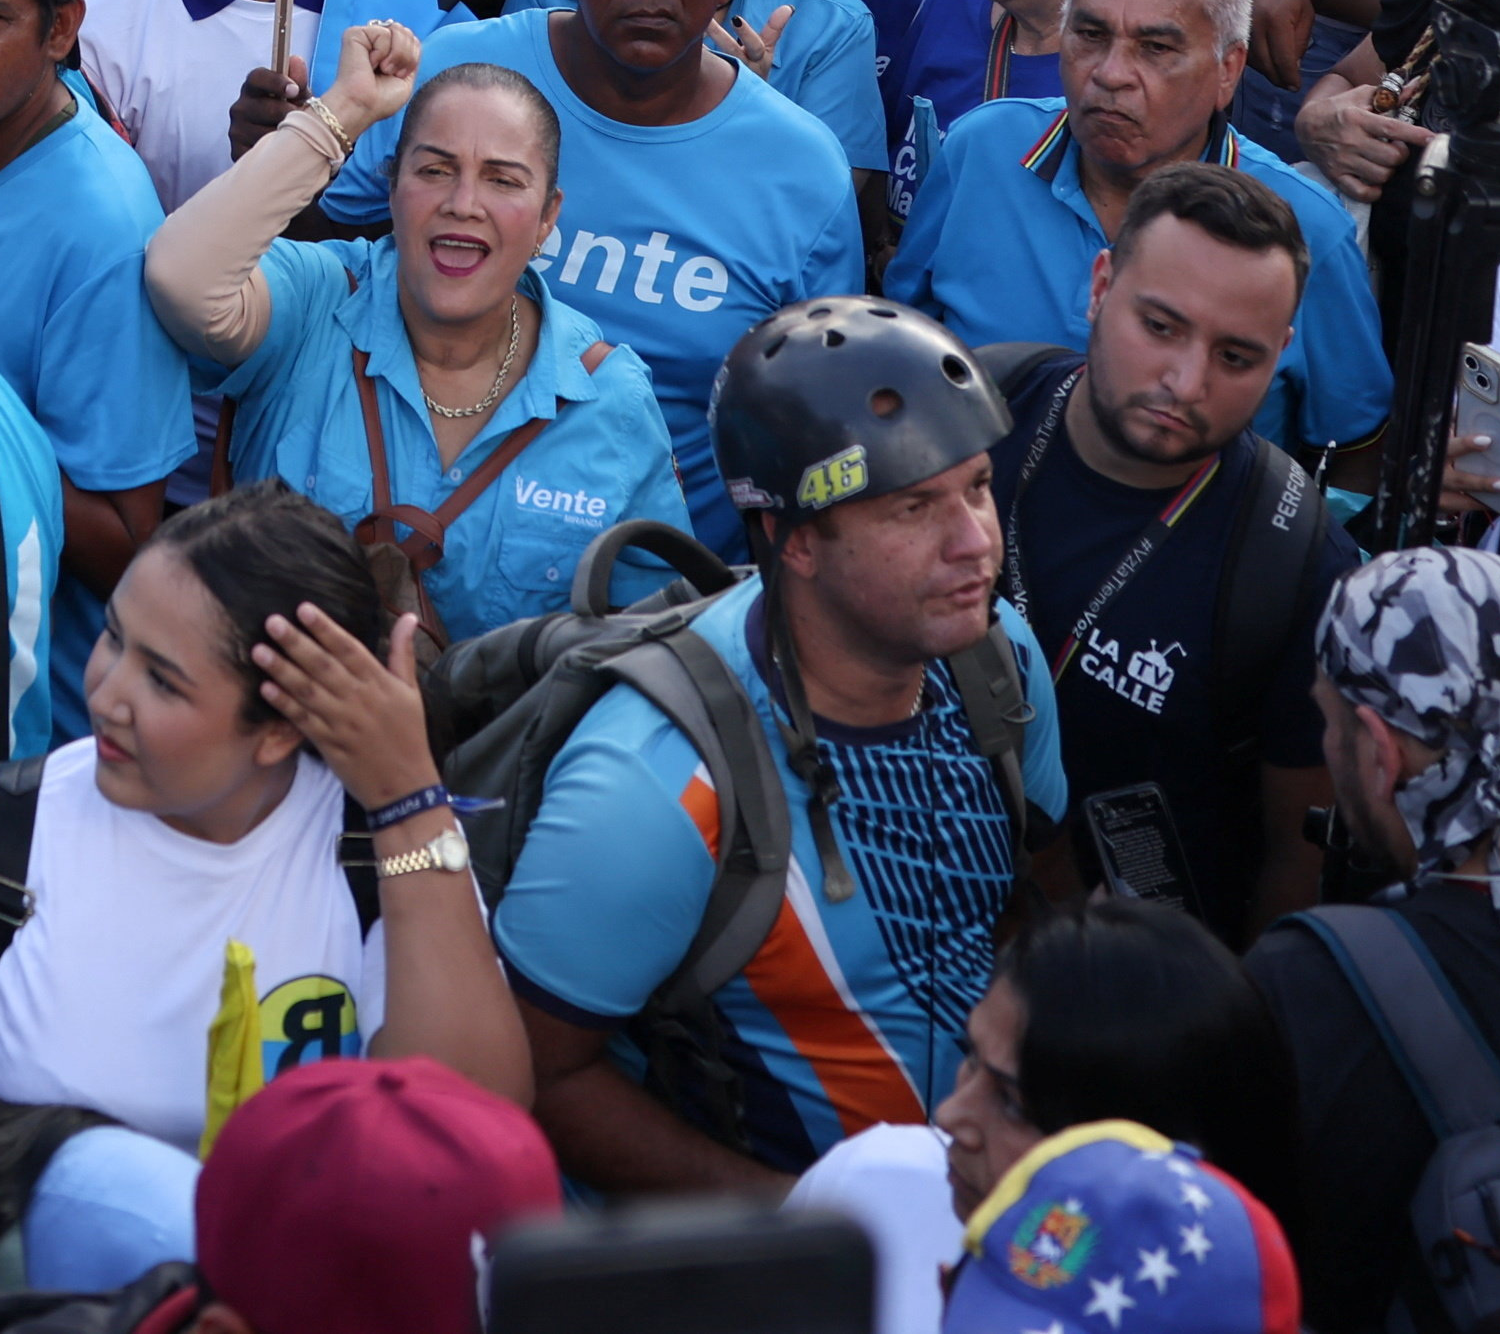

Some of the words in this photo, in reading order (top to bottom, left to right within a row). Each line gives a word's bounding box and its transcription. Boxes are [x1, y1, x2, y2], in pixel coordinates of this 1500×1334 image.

[531, 228, 730, 315] ente
[515, 475, 608, 519] Vente
[796, 444, 868, 512] 46
[1087, 628, 1121, 663] LA
[1080, 653, 1166, 715] CALLE
